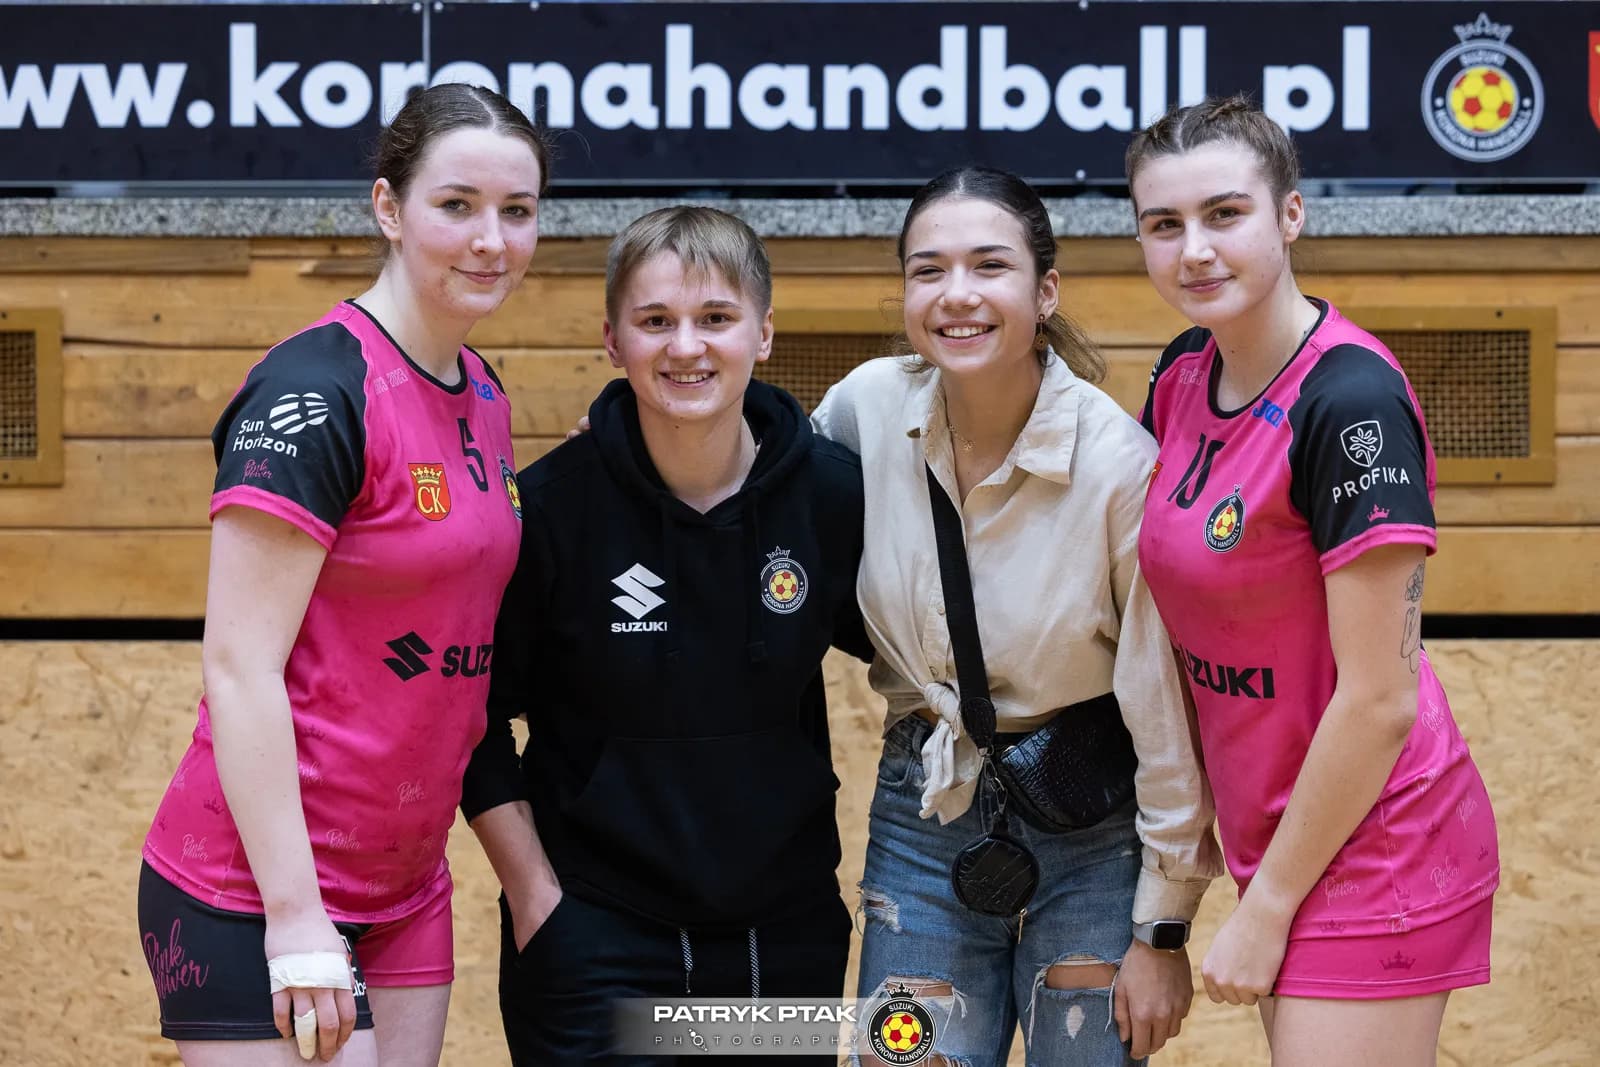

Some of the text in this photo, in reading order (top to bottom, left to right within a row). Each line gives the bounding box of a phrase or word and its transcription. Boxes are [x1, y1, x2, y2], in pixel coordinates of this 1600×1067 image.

[238, 419, 265, 435] Sun
[232, 432, 298, 458] Horizon
[457, 417, 489, 493] 5
[1331, 466, 1411, 505] PROFIKA
[417, 485, 447, 514] CK
[610, 621, 668, 633] SUZUKI
